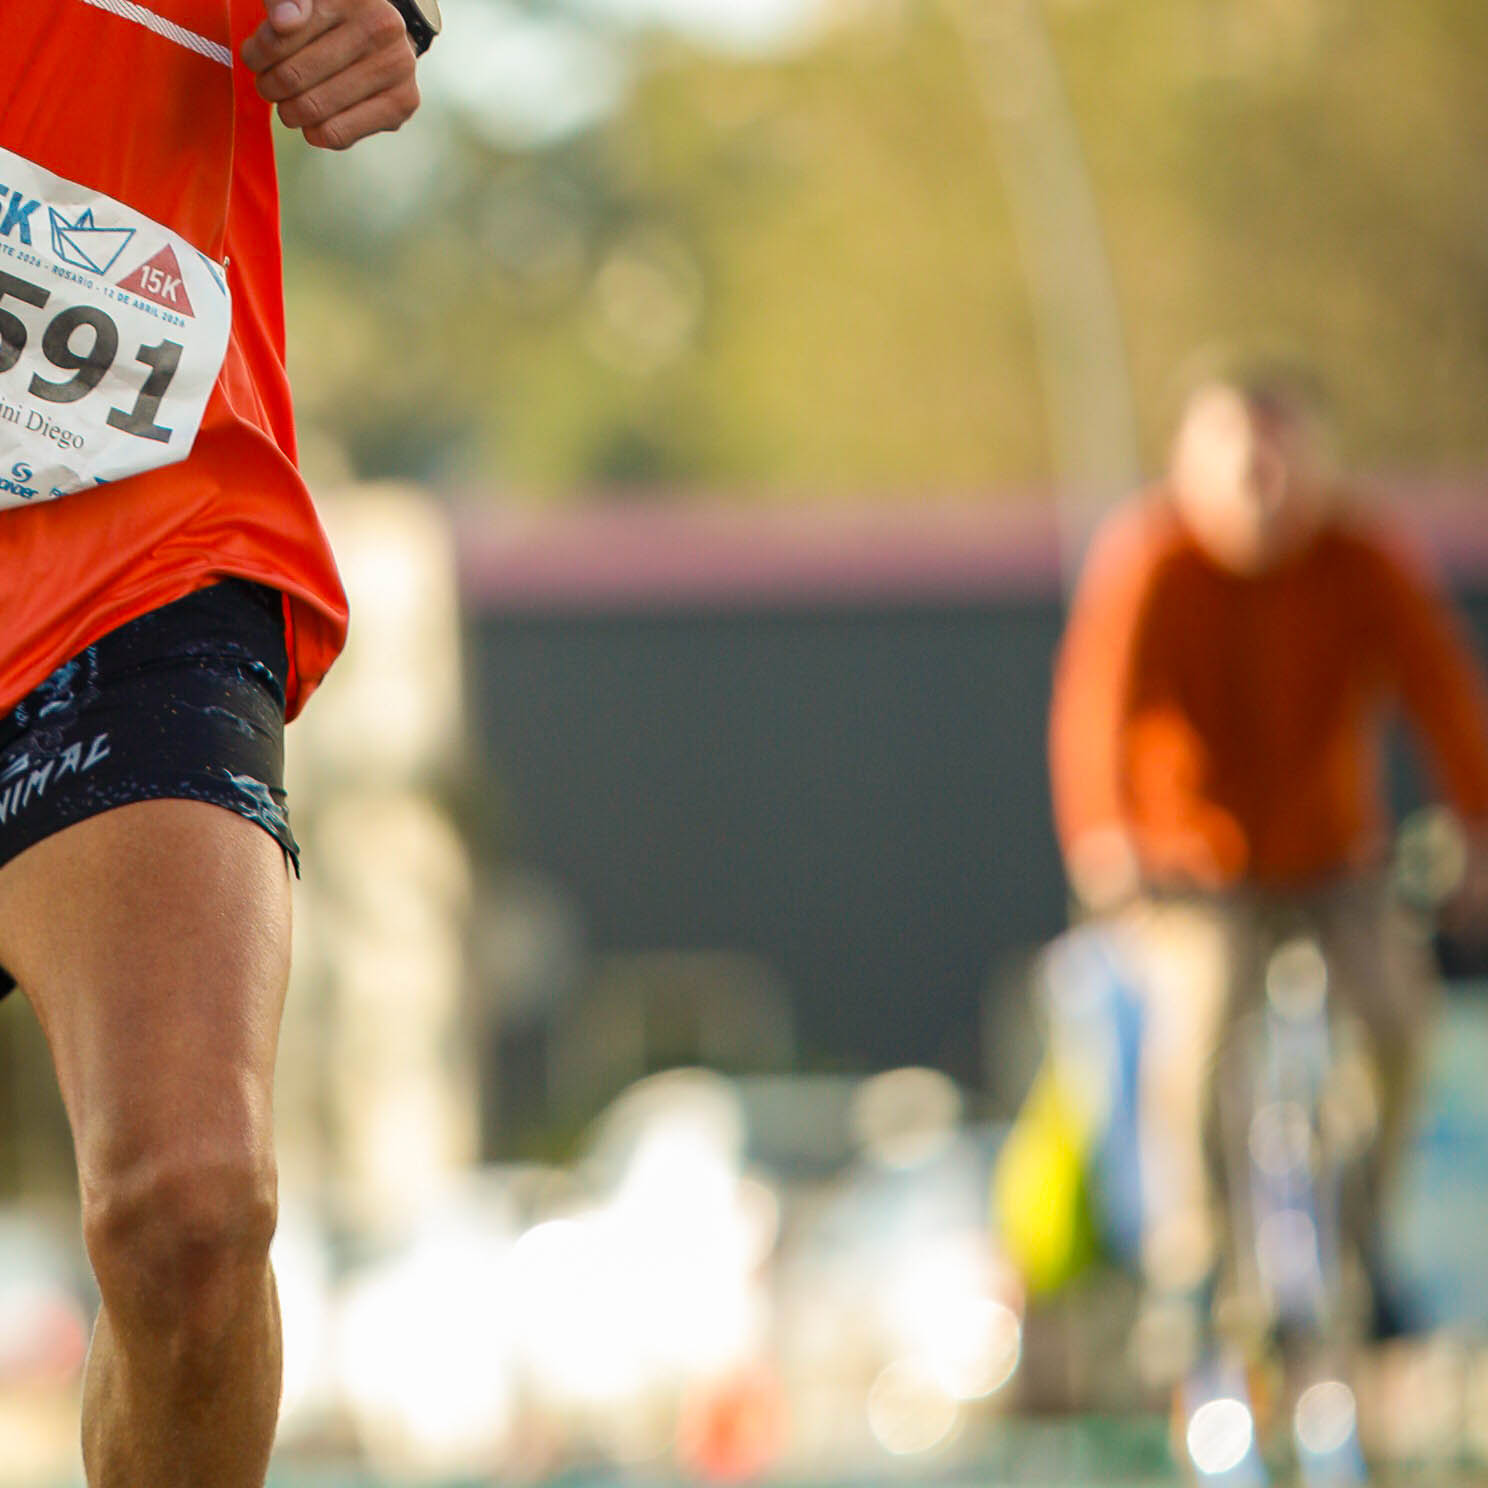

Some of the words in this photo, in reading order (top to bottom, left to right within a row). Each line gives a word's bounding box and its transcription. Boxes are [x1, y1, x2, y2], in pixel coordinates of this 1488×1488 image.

[52, 265, 94, 289] ROSARIO
[104, 287, 114, 298] 12
[117, 292, 130, 304] DE
[133, 297, 159, 317] ABRIL
[140, 265, 182, 303] 15K
[26, 409, 85, 449] Diego
